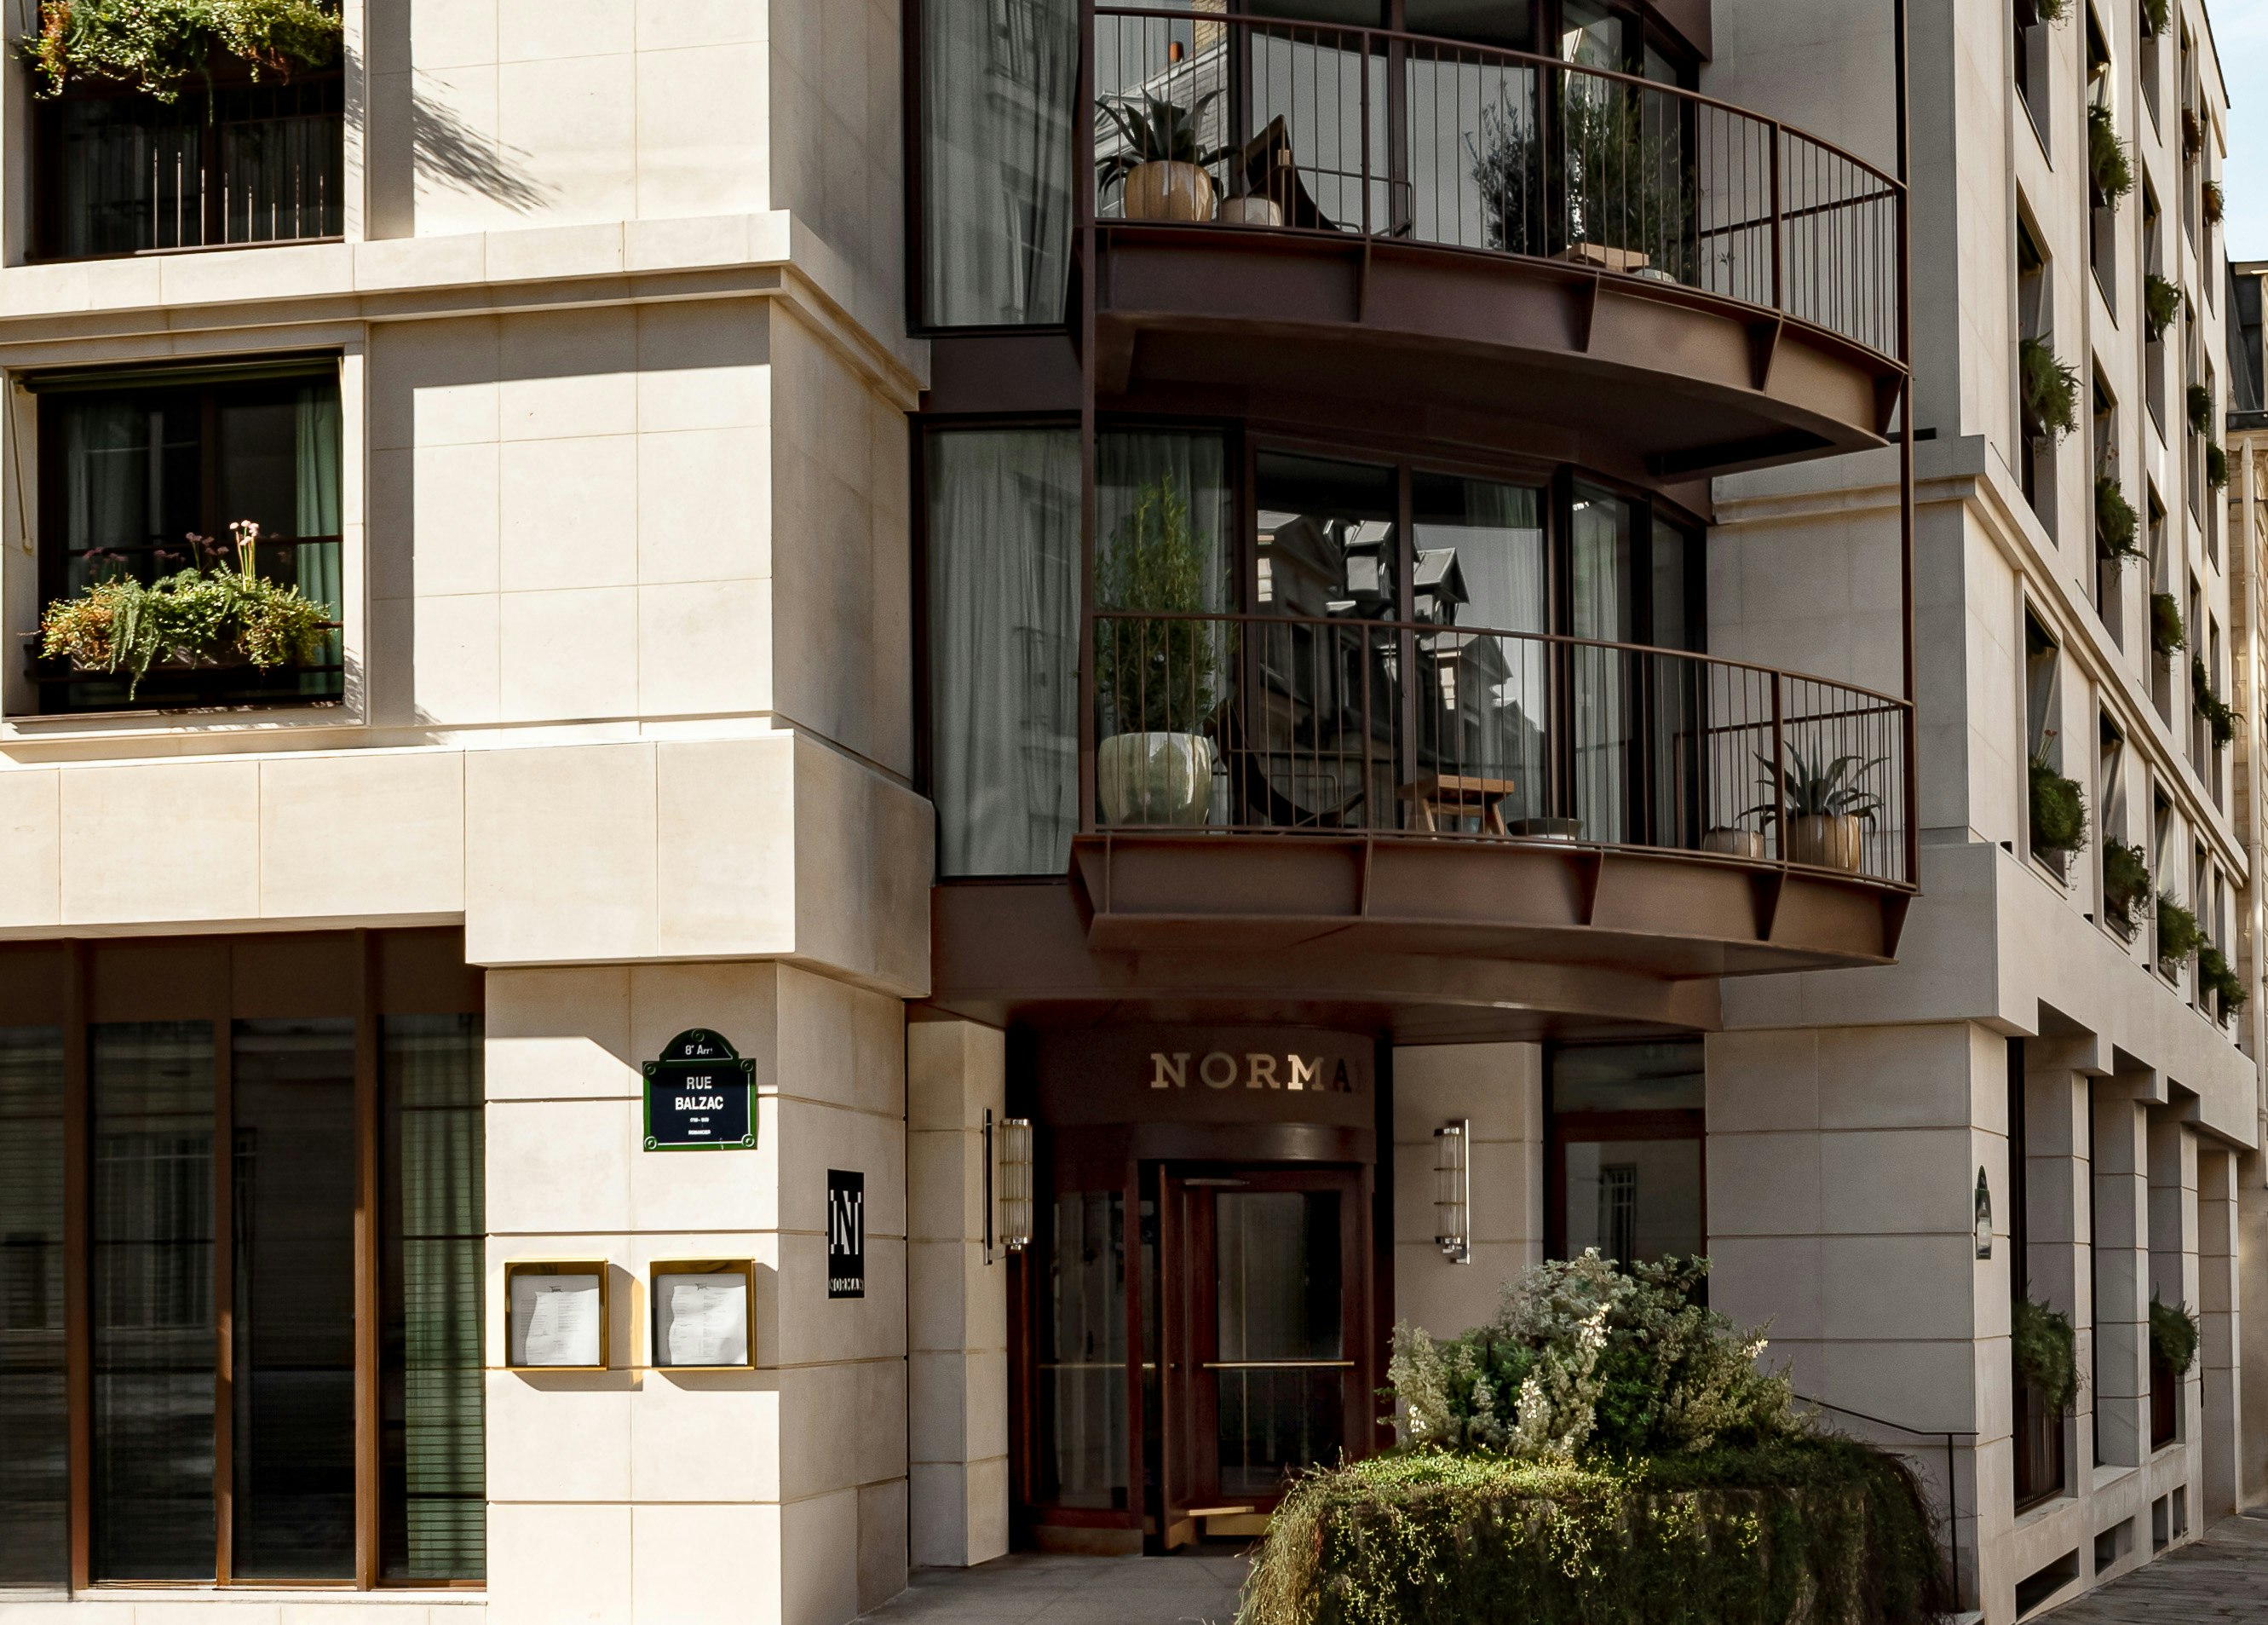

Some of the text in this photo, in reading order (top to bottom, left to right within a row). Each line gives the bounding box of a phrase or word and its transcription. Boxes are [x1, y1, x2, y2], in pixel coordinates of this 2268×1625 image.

[686, 1076, 712, 1090] RUE
[675, 1096, 724, 1110] BALZAC
[830, 1190, 861, 1255] N
